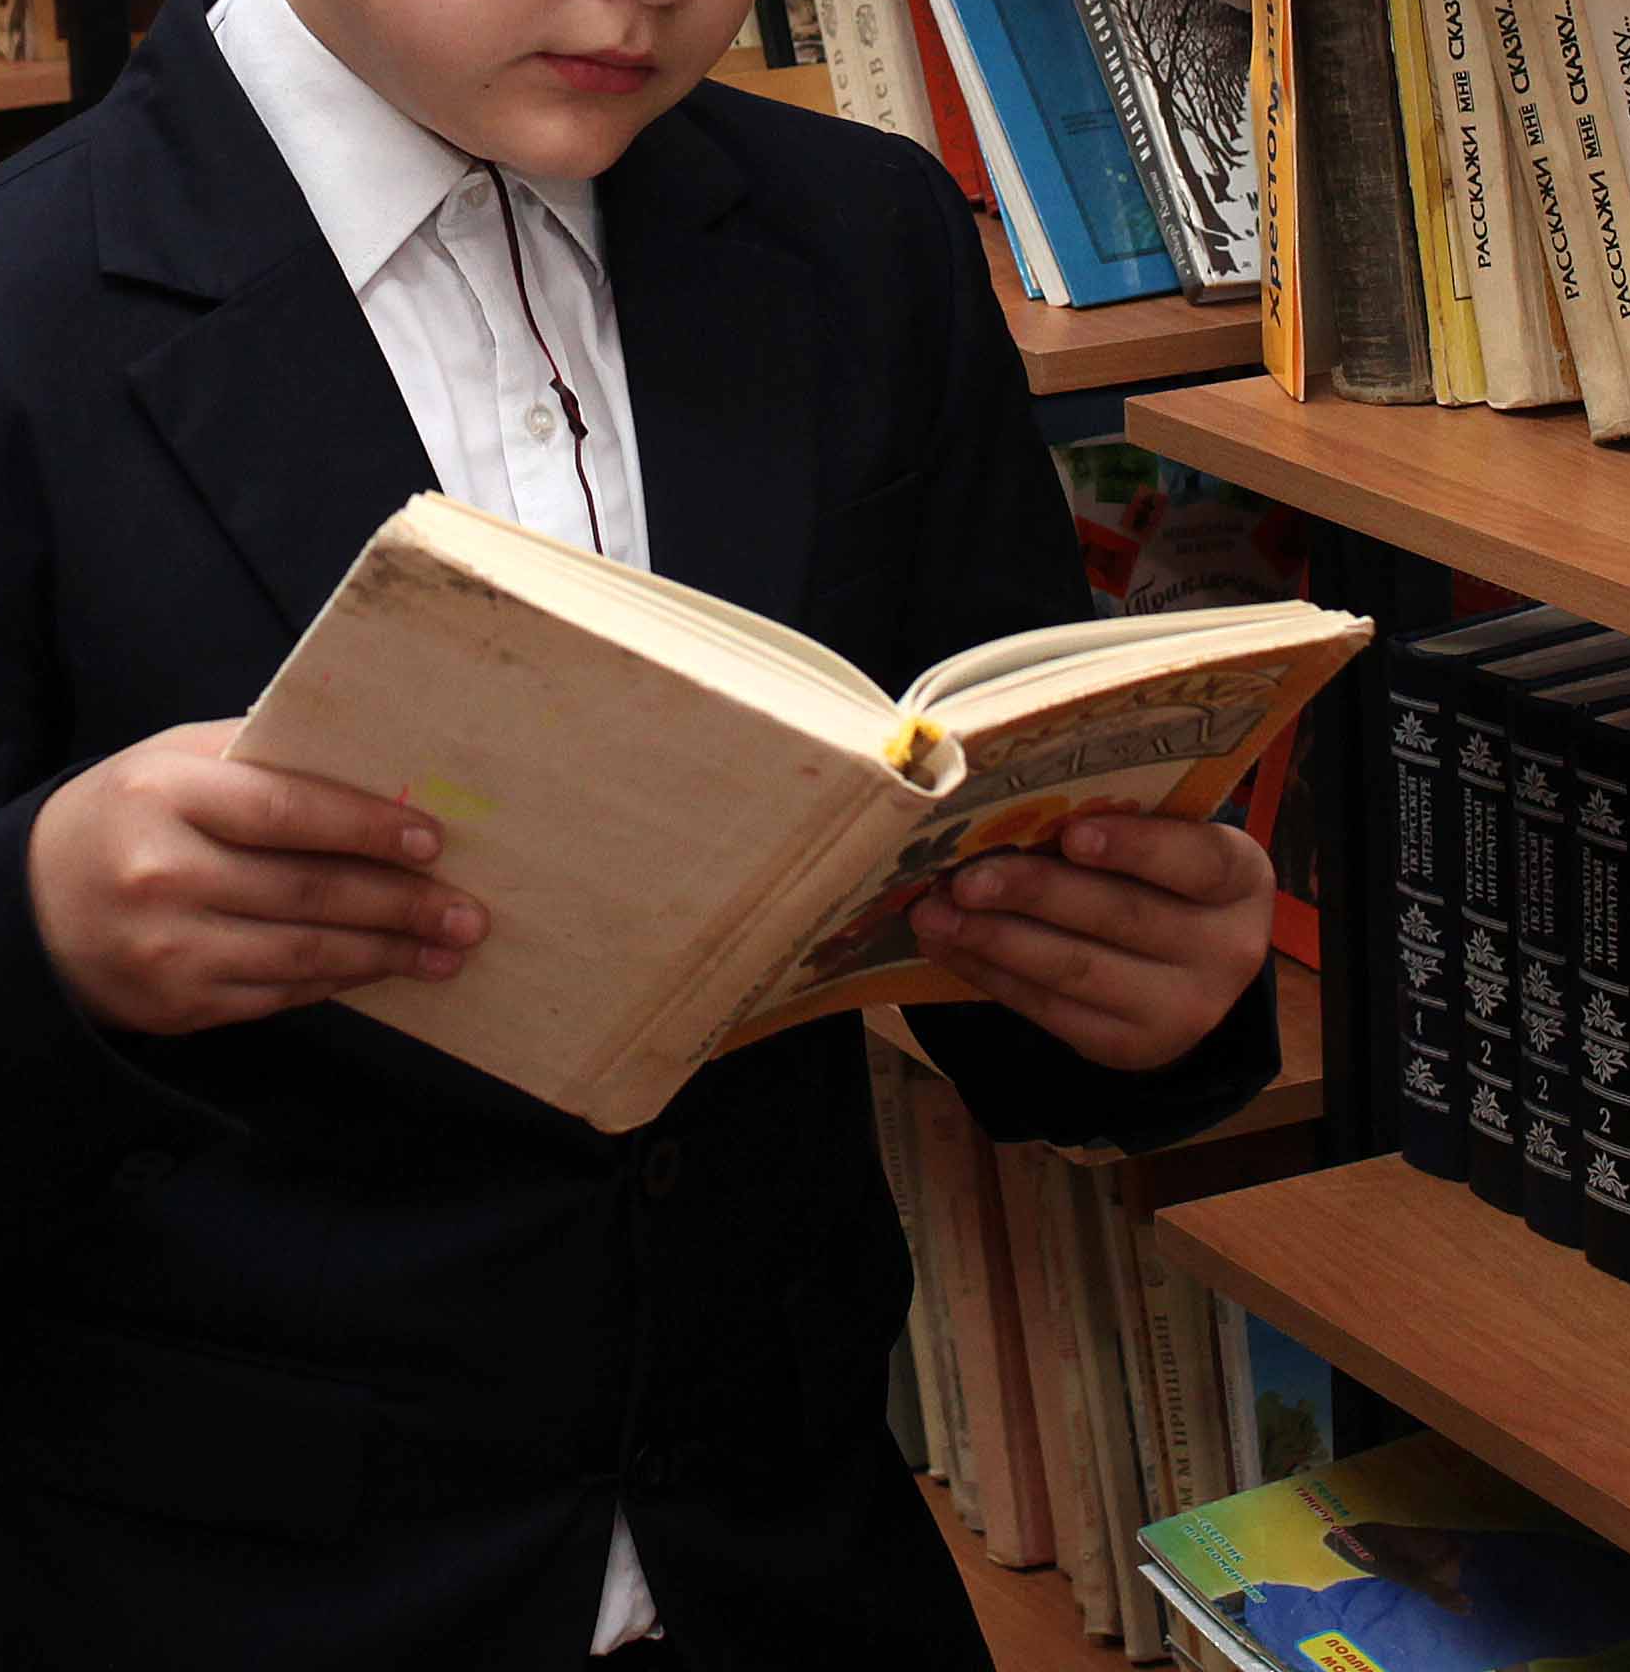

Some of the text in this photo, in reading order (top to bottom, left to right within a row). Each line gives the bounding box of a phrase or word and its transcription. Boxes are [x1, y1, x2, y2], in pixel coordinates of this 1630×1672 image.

[1105, 48, 1154, 165] МАЛЕНЬКИЕ
[1453, 70, 1474, 113] МНЕ
[1519, 103, 1543, 147] МНЕ
[1577, 113, 1600, 159] МНЕ
[1457, 124, 1495, 268] РАССКАЖИ
[1532, 156, 1580, 300] РАССКАЖИ
